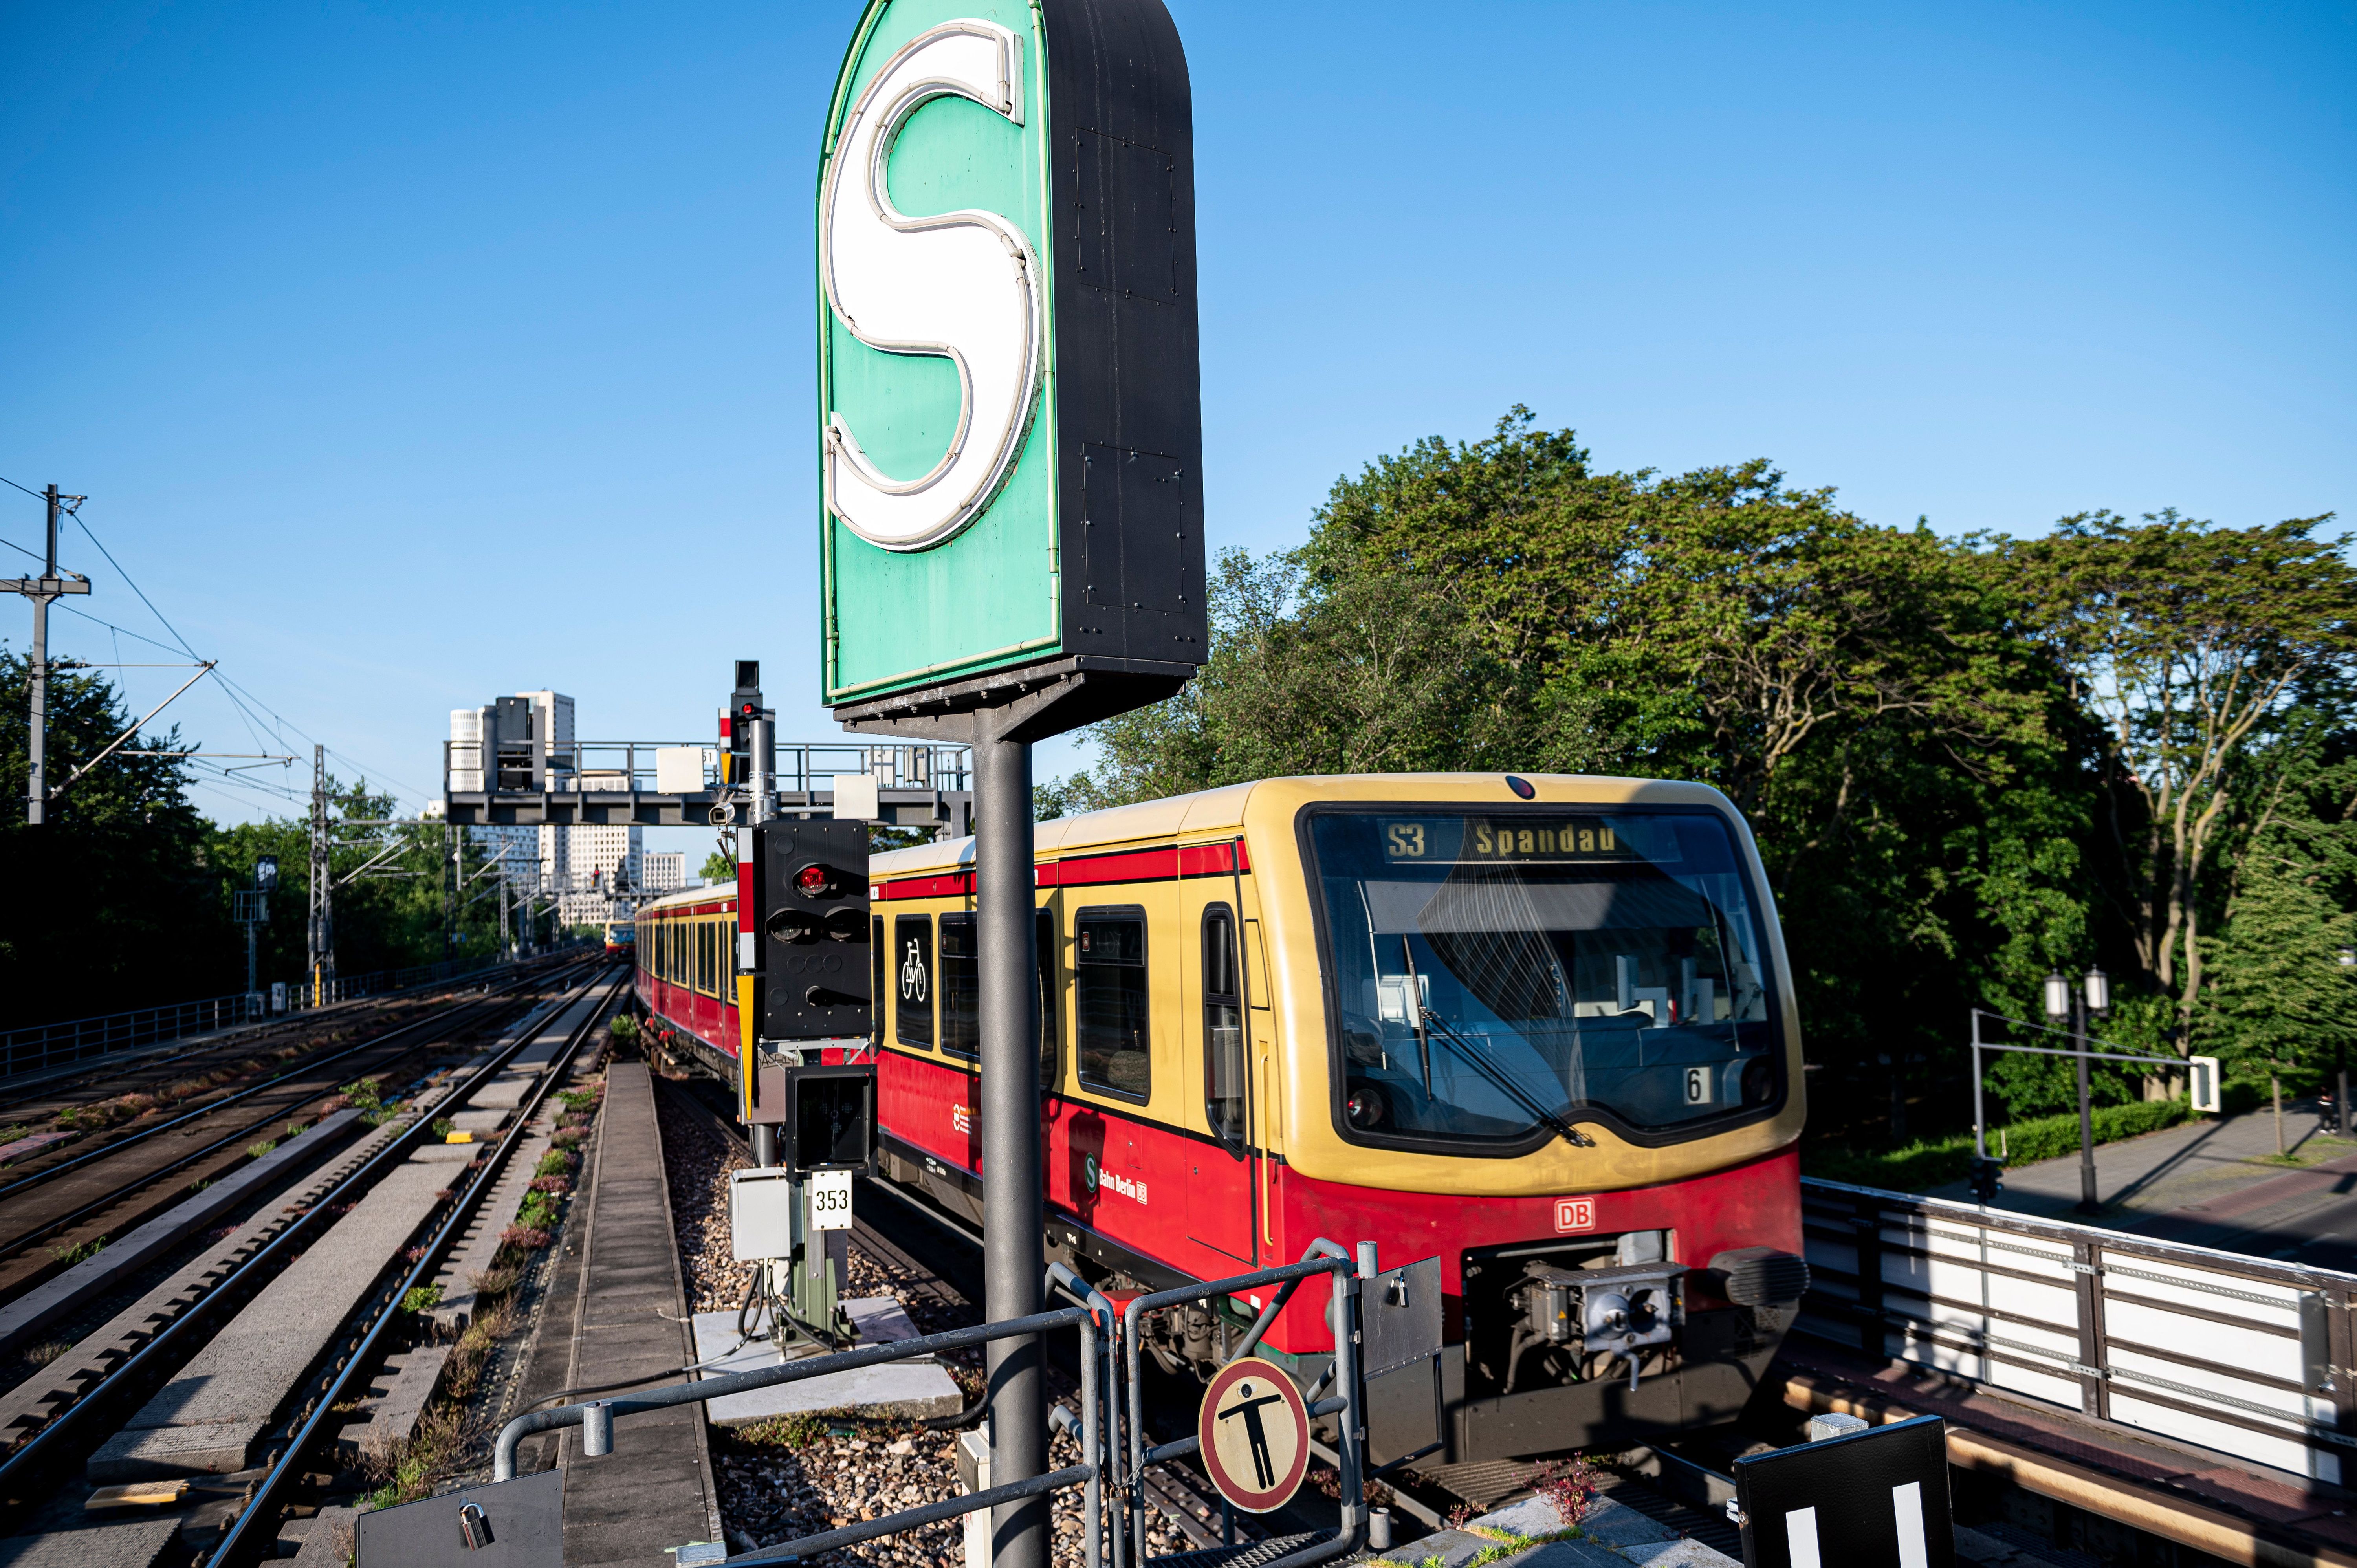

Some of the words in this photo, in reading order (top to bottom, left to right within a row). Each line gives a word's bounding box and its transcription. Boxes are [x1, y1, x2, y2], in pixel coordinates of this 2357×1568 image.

[823, 18, 1043, 553] S
[1388, 823, 1425, 857] S3
[1476, 824, 1616, 857] Spandau
[1687, 1069, 1701, 1101] 6
[1087, 1157, 1096, 1188] S
[1098, 1168, 1115, 1191] Bahn
[1115, 1174, 1136, 1199] Berlin
[816, 1190, 848, 1211] 353
[1561, 1204, 1590, 1226] DB
